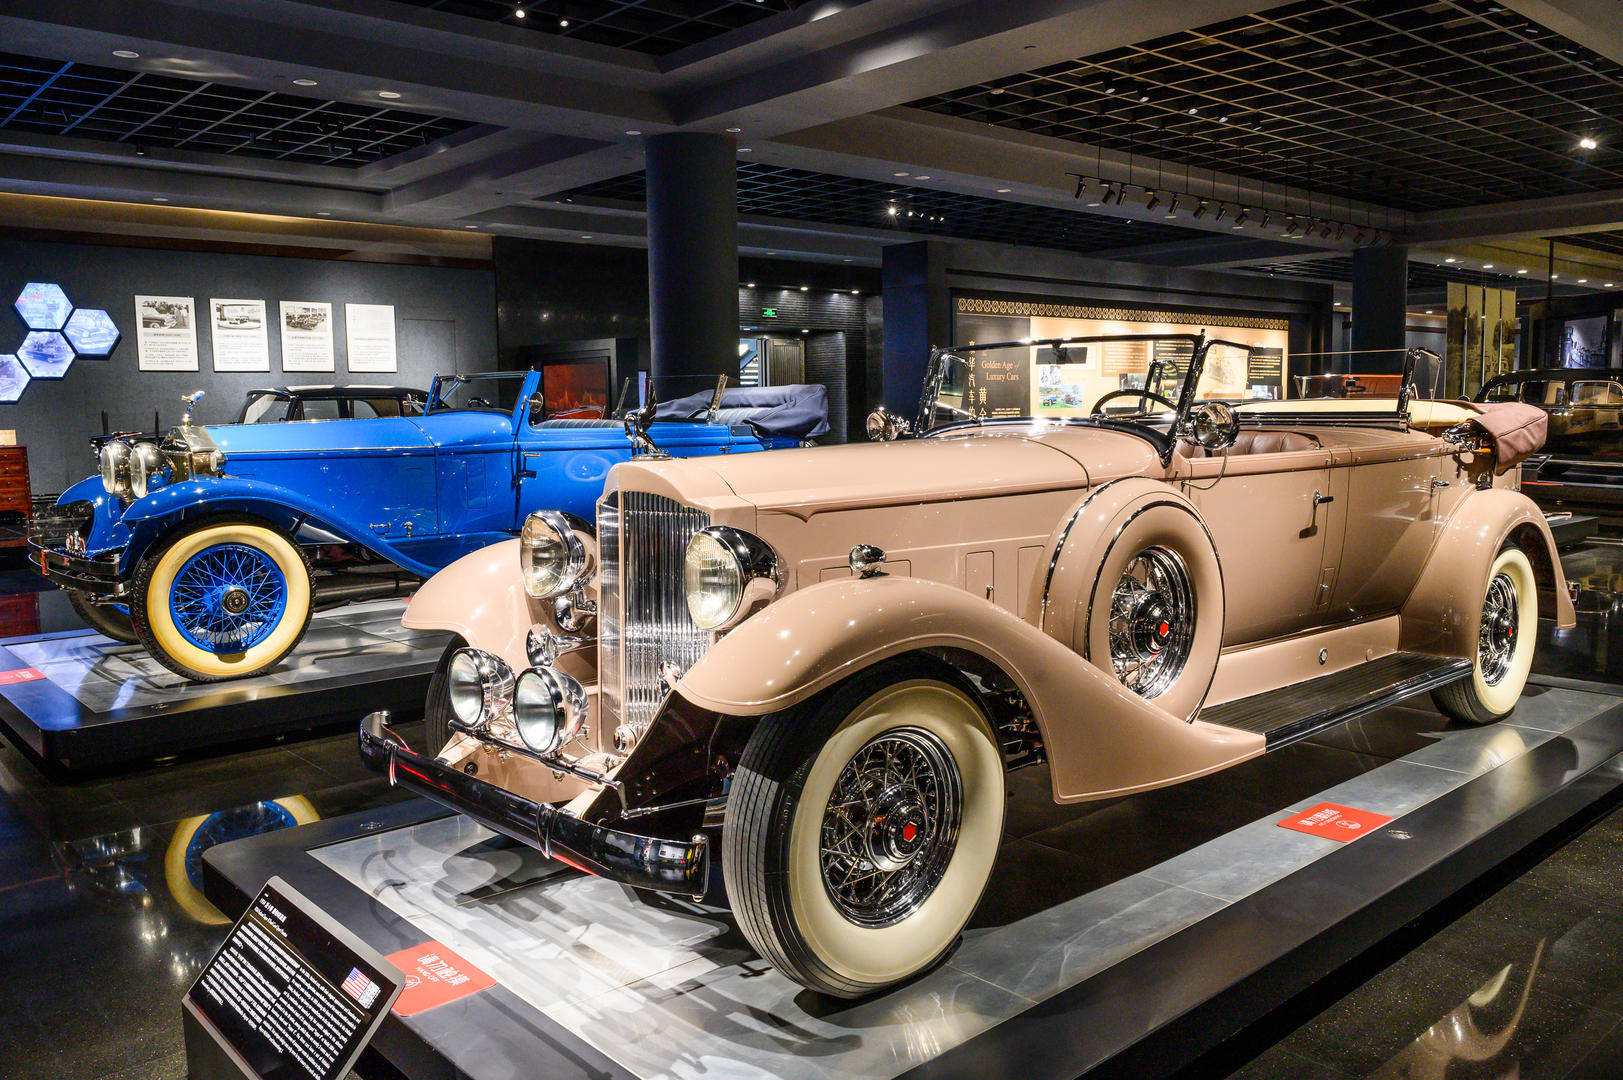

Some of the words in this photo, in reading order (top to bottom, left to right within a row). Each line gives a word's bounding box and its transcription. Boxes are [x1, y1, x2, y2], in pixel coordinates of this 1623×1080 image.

[981, 360, 1001, 369] Golden
[1002, 361, 1013, 371] Age
[986, 372, 1005, 382] Luxury
[1006, 371, 1019, 381] Cars
